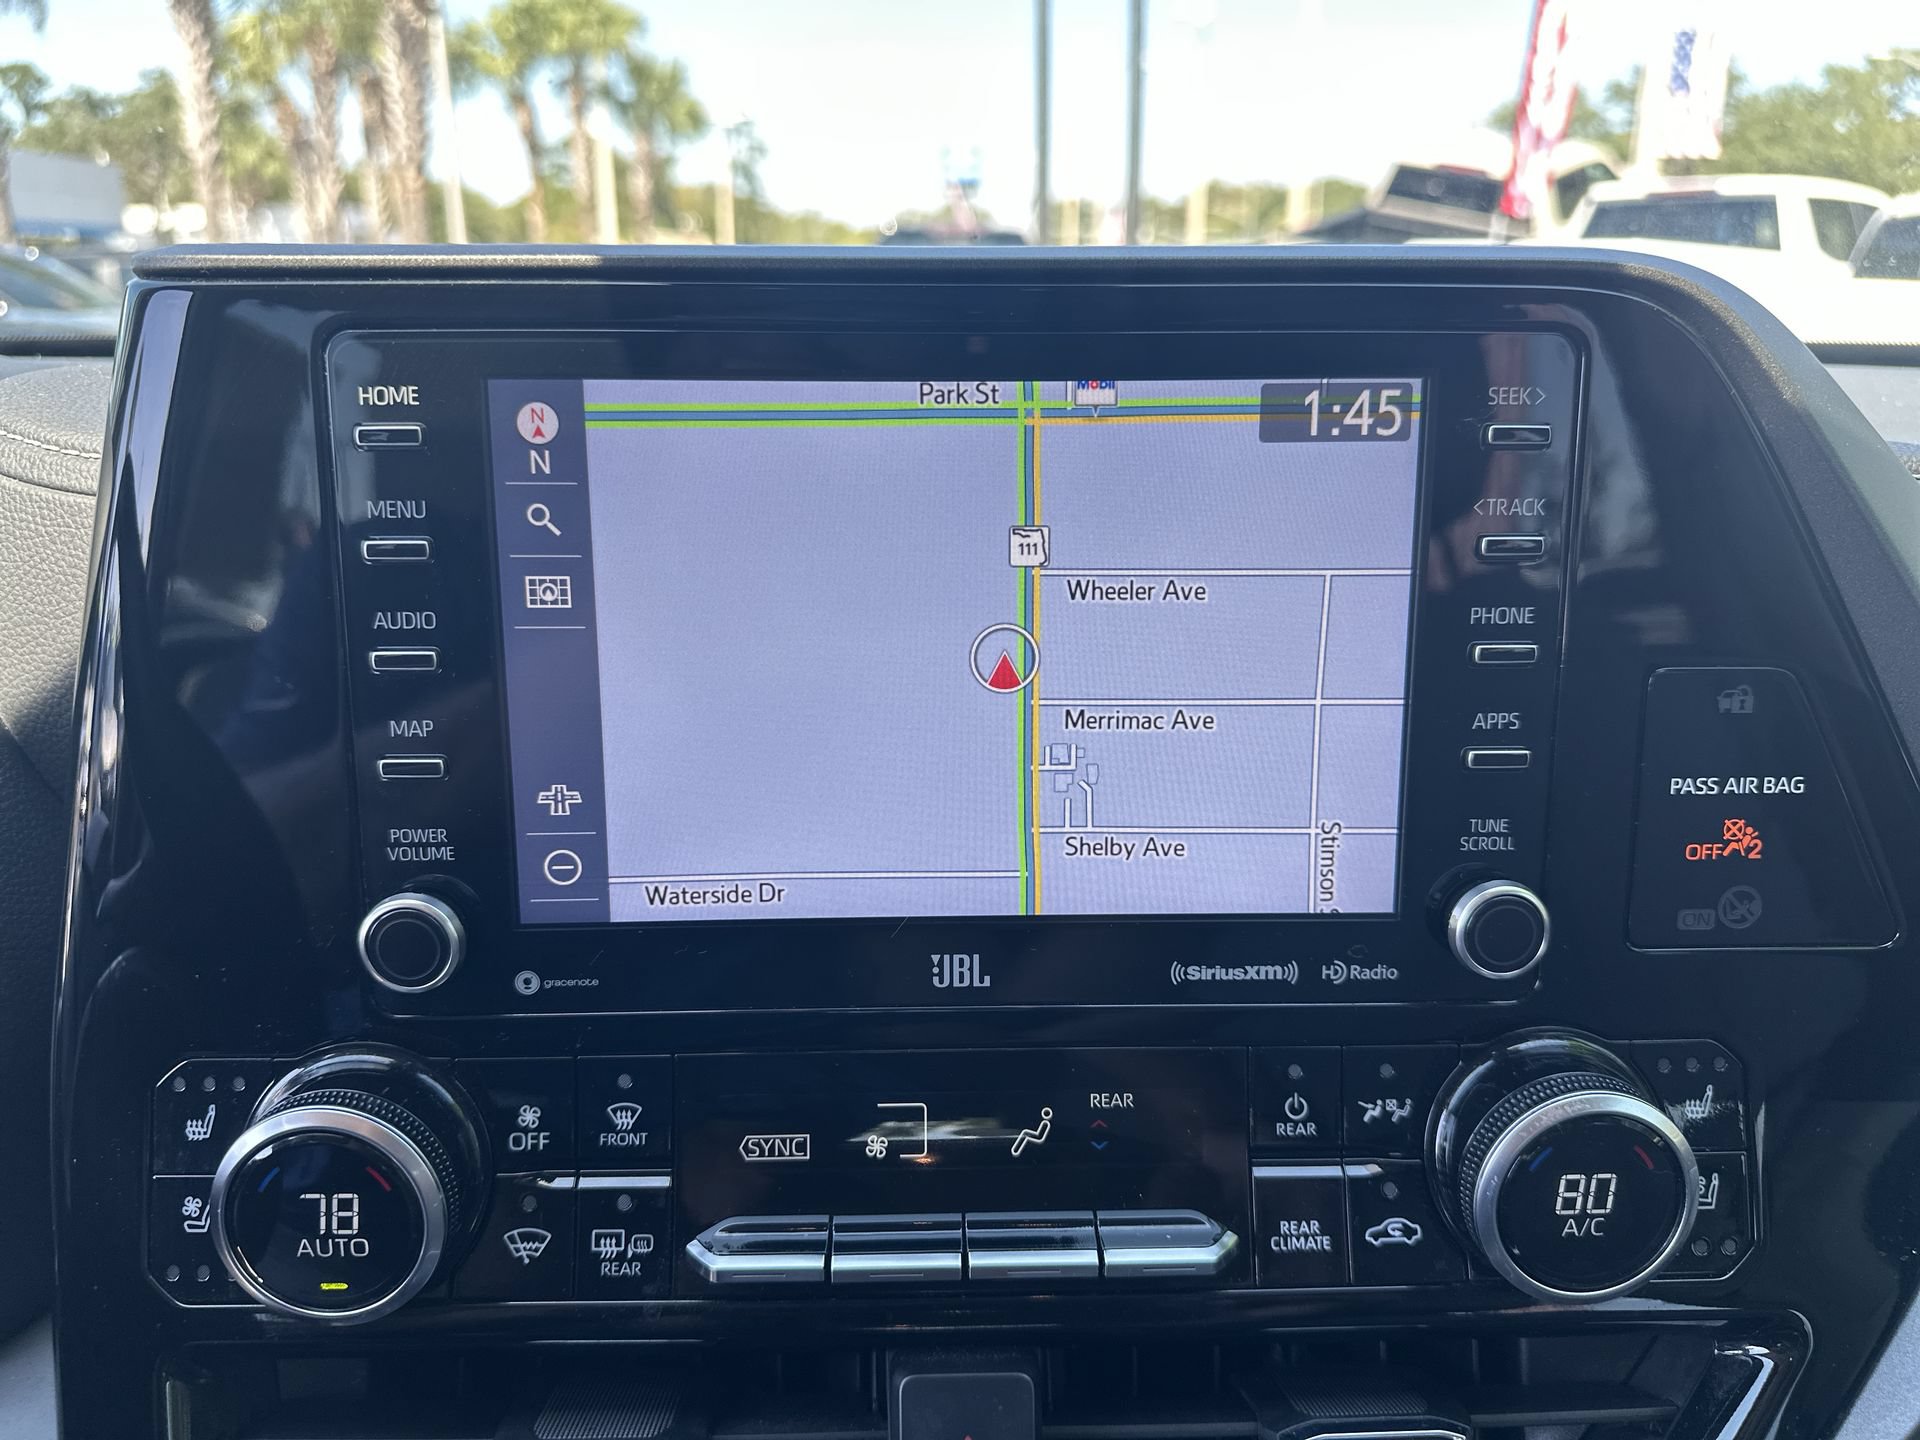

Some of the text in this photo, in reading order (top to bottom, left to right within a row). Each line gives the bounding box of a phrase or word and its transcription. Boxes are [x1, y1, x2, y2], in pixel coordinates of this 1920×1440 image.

[358, 386, 420, 406] HOME
[919, 383, 1000, 405] Park St
[1488, 386, 1532, 406] SEEK
[531, 407, 545, 424] N
[1303, 388, 1402, 437] 1:45
[530, 450, 550, 475] N
[367, 500, 427, 520] MENU
[1487, 498, 1545, 516] TRACK
[1017, 542, 1039, 556] 111
[1067, 579, 1206, 602] Wheeler Ave
[373, 611, 436, 631] AUDIO
[1470, 607, 1535, 625] PHONE
[389, 719, 434, 738] MAP
[1064, 710, 1215, 731] Merrimac Ave
[1472, 712, 1520, 731] APPS
[1670, 776, 1805, 796] PASS AIR BAG
[1469, 819, 1509, 834] TUNE
[389, 829, 448, 844] POWER
[1460, 836, 1514, 852] SCROLL
[387, 846, 455, 862] VOLUME
[1064, 836, 1185, 861] Shelby Ave
[1685, 839, 1762, 860] OFF 2
[1320, 822, 1342, 902] Stimson
[645, 883, 785, 907] Waterside Dr
[931, 954, 991, 988] JBL
[1350, 963, 1398, 980] Radio
[544, 979, 599, 989] gracenote
[1090, 1093, 1134, 1108] REAR
[1276, 1122, 1316, 1136] REAR
[509, 1133, 550, 1152] OFF
[599, 1133, 648, 1147] FRONT
[747, 1138, 805, 1157] SYNC
[1554, 1173, 1618, 1215] 80
[300, 1193, 360, 1235] 78
[1279, 1220, 1321, 1235] REAR
[1561, 1218, 1606, 1238] A/C
[296, 1239, 370, 1258] AUTO
[1270, 1235, 1333, 1252] CLIMATE
[600, 1262, 642, 1276] REAR
